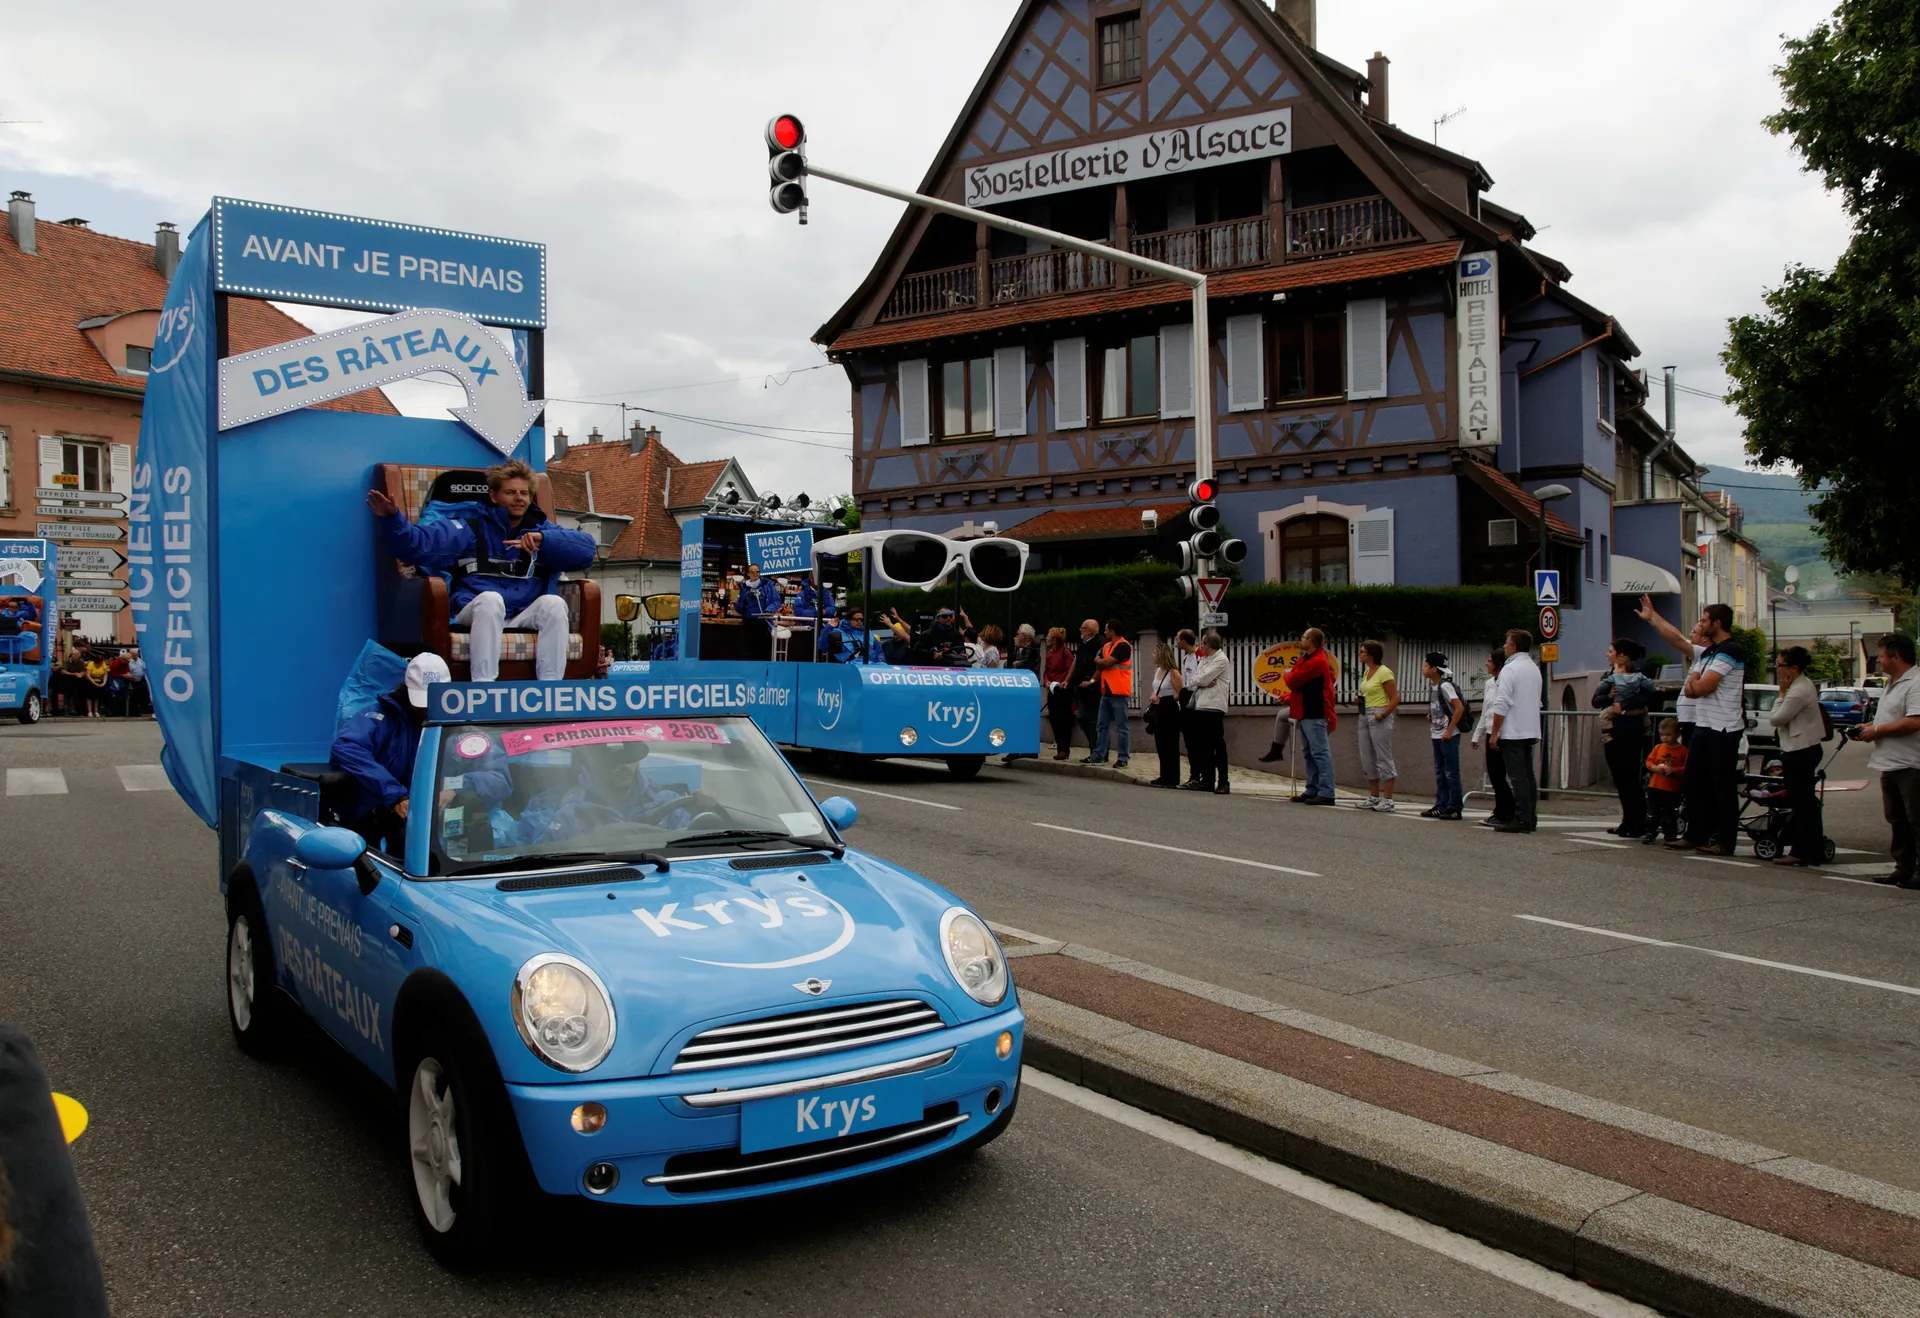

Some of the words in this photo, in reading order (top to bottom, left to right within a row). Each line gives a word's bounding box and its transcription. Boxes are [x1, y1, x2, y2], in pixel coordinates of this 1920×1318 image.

[967, 146, 1129, 206] Hostellerie
[1142, 120, 1288, 172] d'Alsace
[241, 234, 346, 269] AVANT
[353, 250, 391, 276] JE
[400, 255, 524, 293] PRENAIS
[1459, 279, 1494, 298] HOTEL
[252, 356, 329, 397] DES
[336, 327, 499, 387] RÂTEAUX
[1467, 299, 1488, 441] RESTAURANT
[38, 490, 79, 499] UFFHOLTZ
[450, 482, 489, 493] sparco
[38, 507, 84, 515] STEINBACH
[38, 523, 68, 531] CENTRE
[682, 543, 702, 560] KRYS
[758, 536, 785, 548] MAIS
[786, 535, 801, 548] ÇA
[681, 568, 702, 578] OFFICIELS
[763, 558, 796, 570] AVANT
[163, 465, 194, 702] OFFICIELS
[1620, 580, 1656, 592] Hôtel
[1543, 615, 1554, 629] 30
[612, 664, 650, 672] OPTICIENS
[1267, 656, 1285, 666] DA
[870, 672, 952, 687] OPTICIENS
[956, 674, 1032, 689] OFFICIELS
[440, 685, 618, 715] OPTICIENS
[625, 683, 747, 711] OFFICIELS
[758, 682, 790, 706] aimer
[817, 687, 840, 713] Krys
[927, 701, 975, 728] Krys
[543, 726, 636, 744] CARAVANE
[668, 723, 719, 741] 2588
[305, 895, 317, 926] JE
[317, 901, 362, 957] PRENAIS
[631, 895, 828, 938] Krys
[278, 923, 303, 982] DES
[304, 944, 385, 1052] RÂTEAUX
[796, 1094, 877, 1137] Krys
